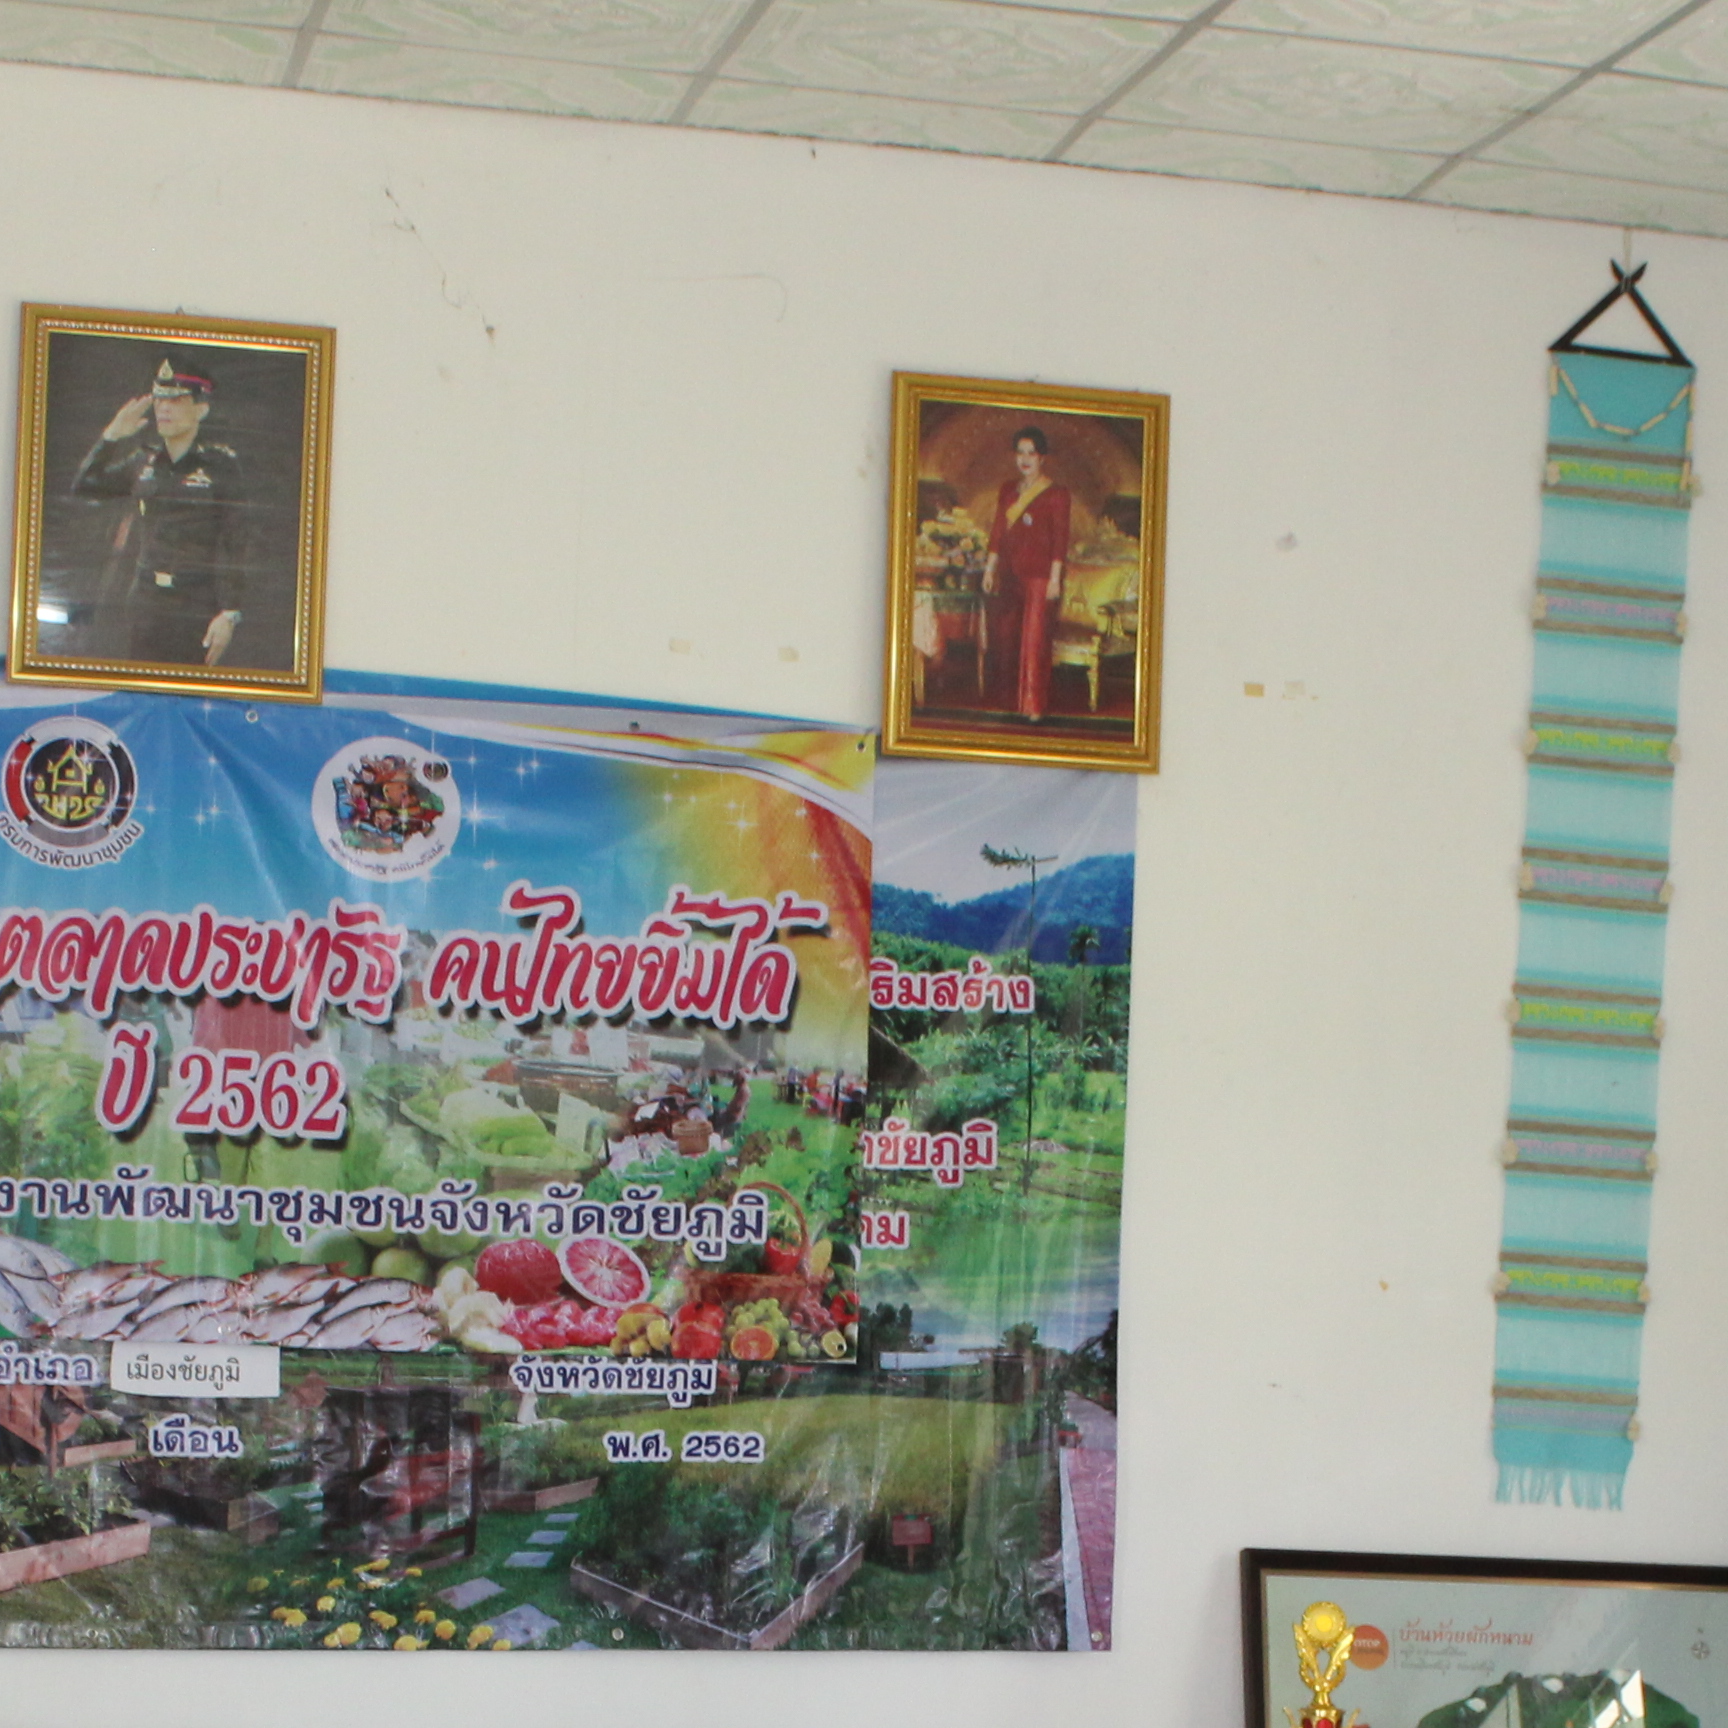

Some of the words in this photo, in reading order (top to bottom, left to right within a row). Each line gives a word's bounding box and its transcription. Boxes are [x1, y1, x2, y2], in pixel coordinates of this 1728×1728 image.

[429, 887, 822, 1022] คนไทยยิ้มได้
[102, 1029, 151, 1124] ปี
[176, 1054, 341, 1133] 2562
[127, 1354, 241, 1391] เมืองชัยภูมิ
[153, 1416, 239, 1453] เดือน
[608, 1433, 667, 1458] พ.ศ.
[686, 1435, 760, 1458] 2562
